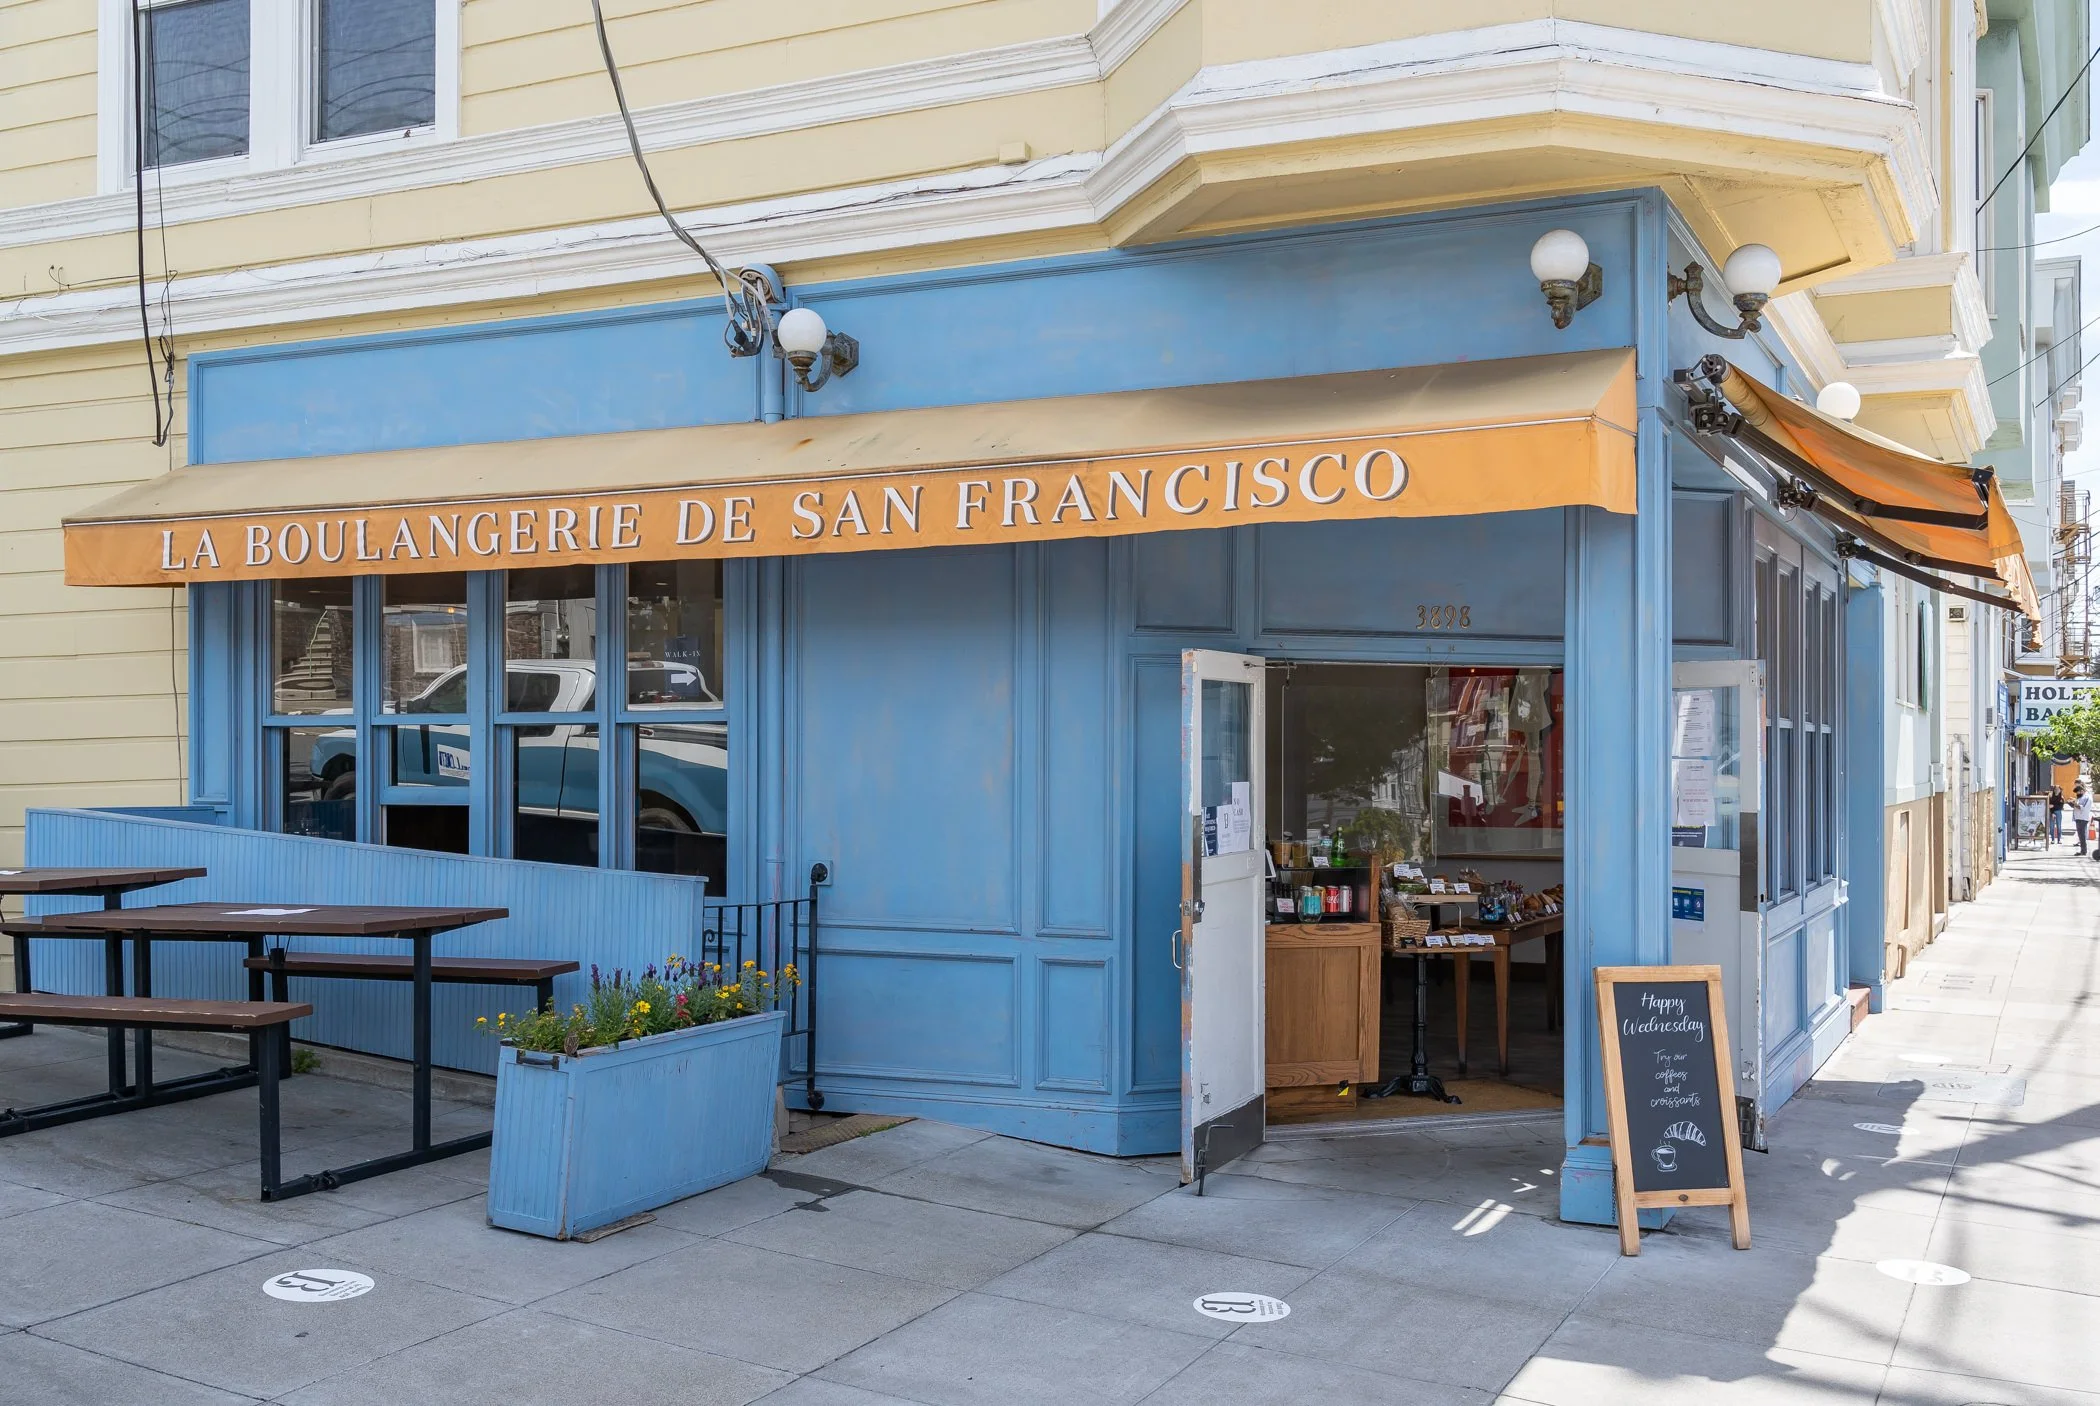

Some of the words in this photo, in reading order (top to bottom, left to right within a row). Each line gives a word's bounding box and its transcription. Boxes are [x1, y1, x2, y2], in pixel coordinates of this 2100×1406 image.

[161, 529, 220, 570] LA
[245, 503, 642, 566] BOULANGERIE
[675, 496, 756, 545] DE
[791, 485, 924, 539] SAN
[955, 448, 1410, 529] FRANCISCO
[1415, 605, 1471, 629] 3898
[1641, 992, 1686, 1015] Happy
[1623, 1015, 1705, 1043] Wednesday
[1653, 1048, 1672, 1068] Try
[1673, 1053, 1688, 1061] our
[1655, 1068, 1688, 1085] coffees
[1663, 1082, 1680, 1094] and
[1650, 1092, 1701, 1109] croissants
